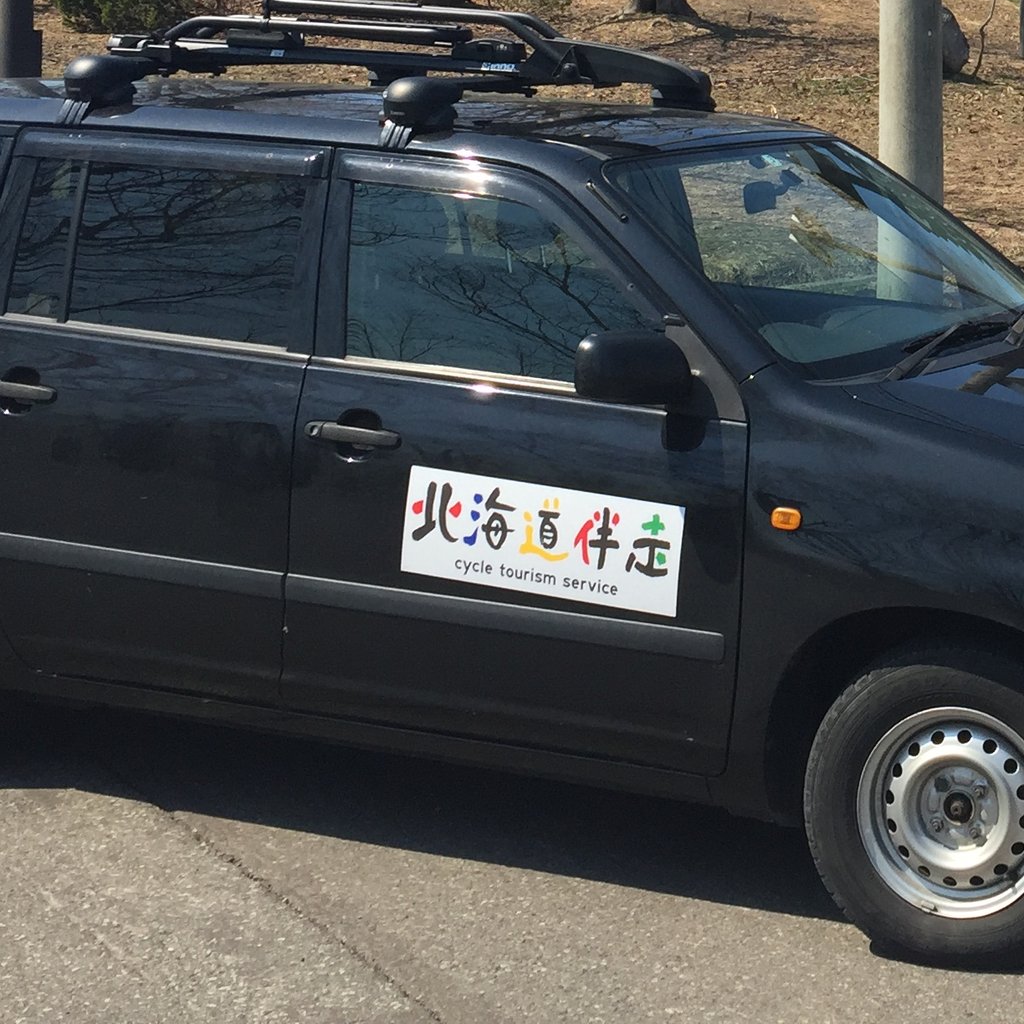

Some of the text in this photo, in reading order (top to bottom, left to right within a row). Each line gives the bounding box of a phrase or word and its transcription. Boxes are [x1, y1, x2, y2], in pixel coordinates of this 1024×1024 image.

[411, 480, 671, 578] 北海道伴走
[454, 558, 619, 596] cycle tourism service
